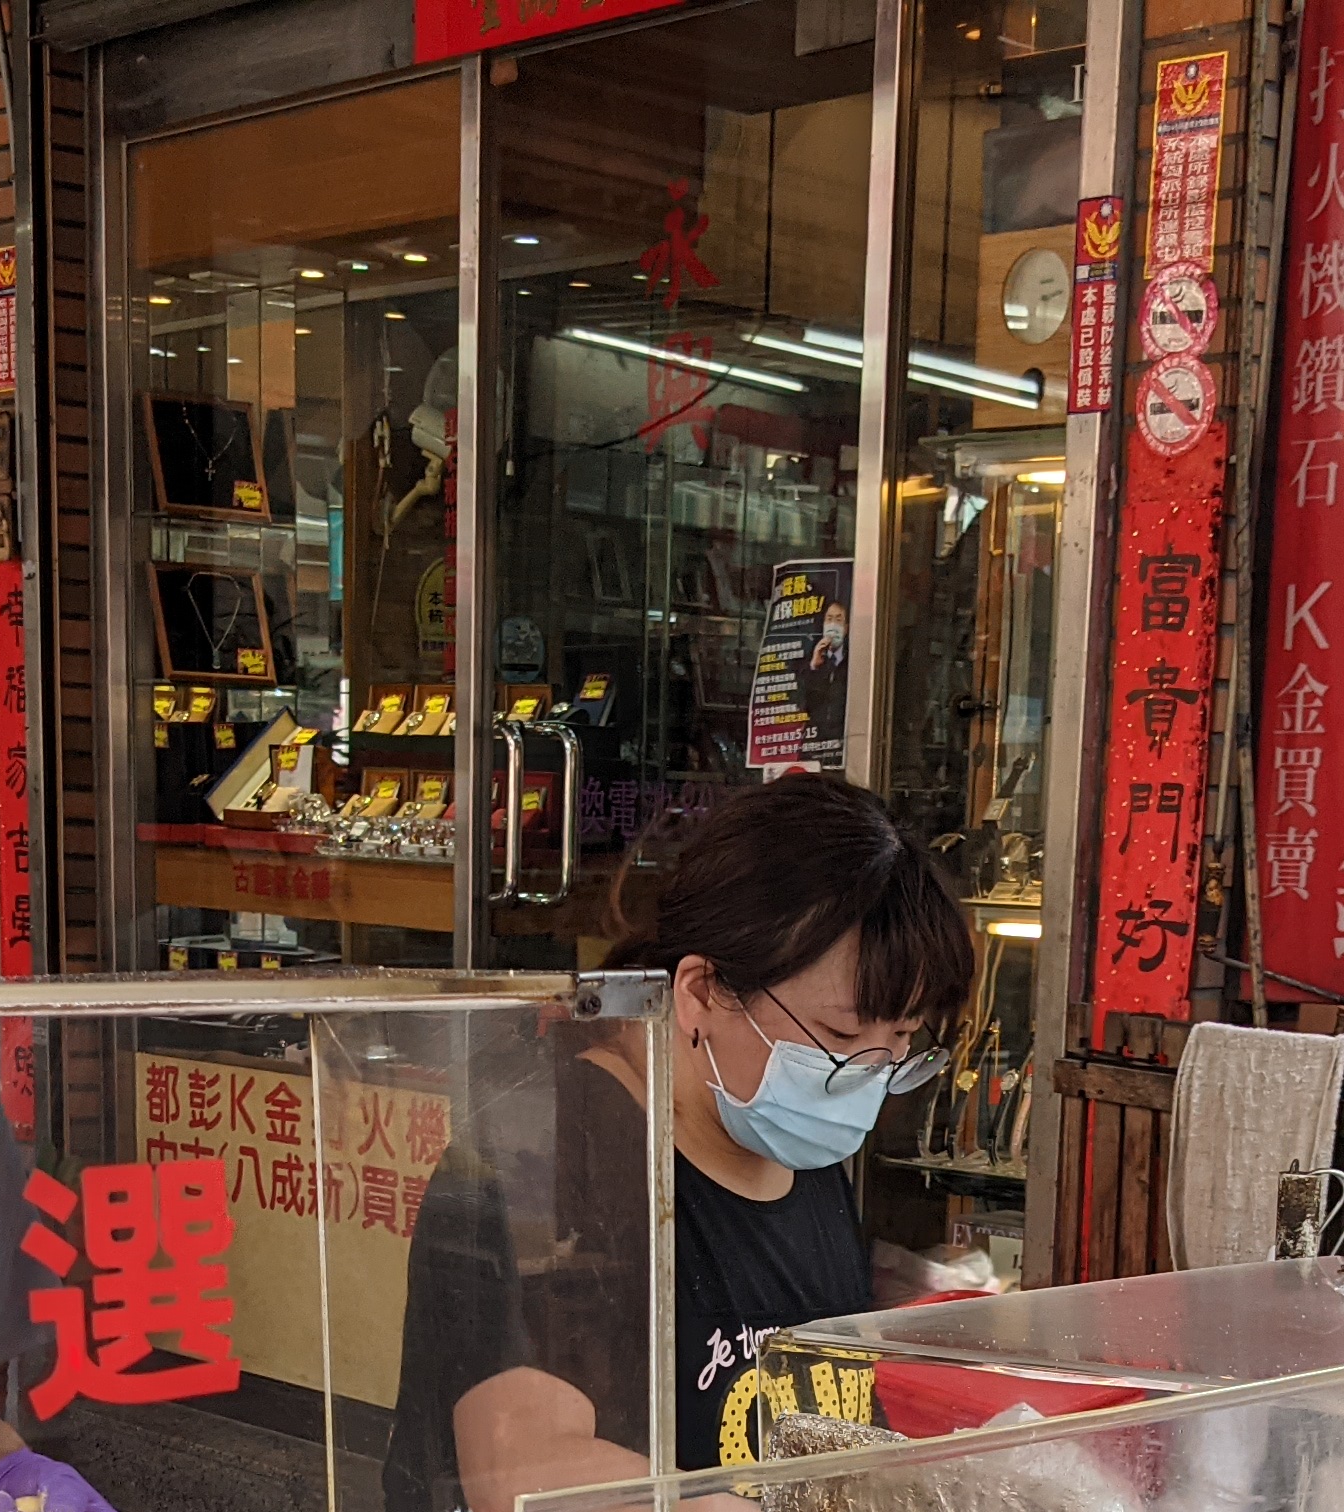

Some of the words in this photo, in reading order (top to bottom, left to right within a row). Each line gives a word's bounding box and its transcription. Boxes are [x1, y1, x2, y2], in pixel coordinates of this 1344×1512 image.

[1111, 550, 1202, 973] 富貴門好
[1261, 581, 1333, 902] K金買賣
